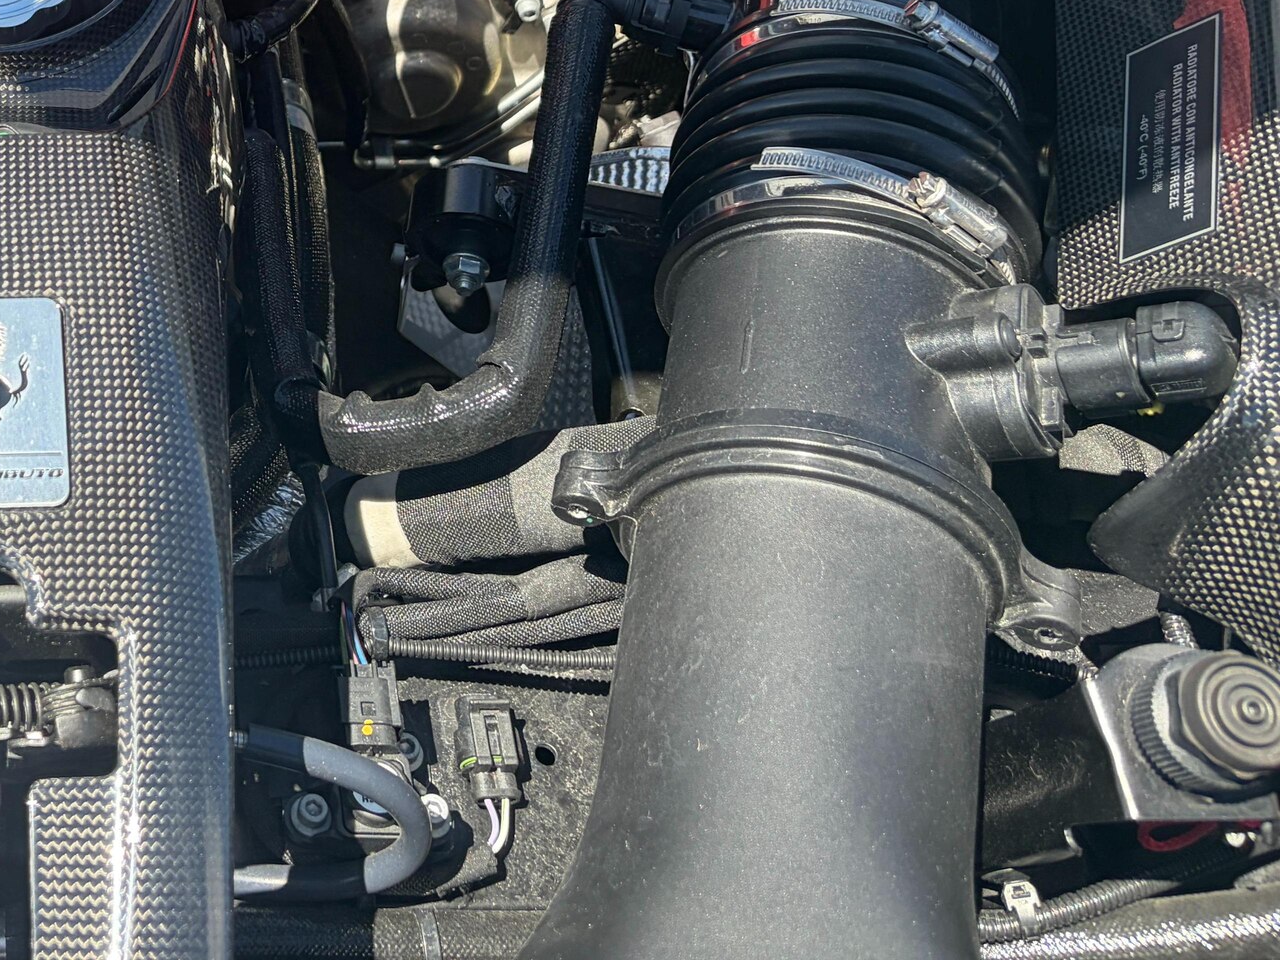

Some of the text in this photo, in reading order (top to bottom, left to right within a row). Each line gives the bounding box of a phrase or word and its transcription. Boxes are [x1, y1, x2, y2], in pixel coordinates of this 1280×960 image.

[1136, 114, 1149, 180] -40°C (-40°F)
[1169, 63, 1183, 209] RADIATOR WITH ANTIFREEZE
[1183, 44, 1198, 221] RADIATORE CON ANTICONGELANTE
